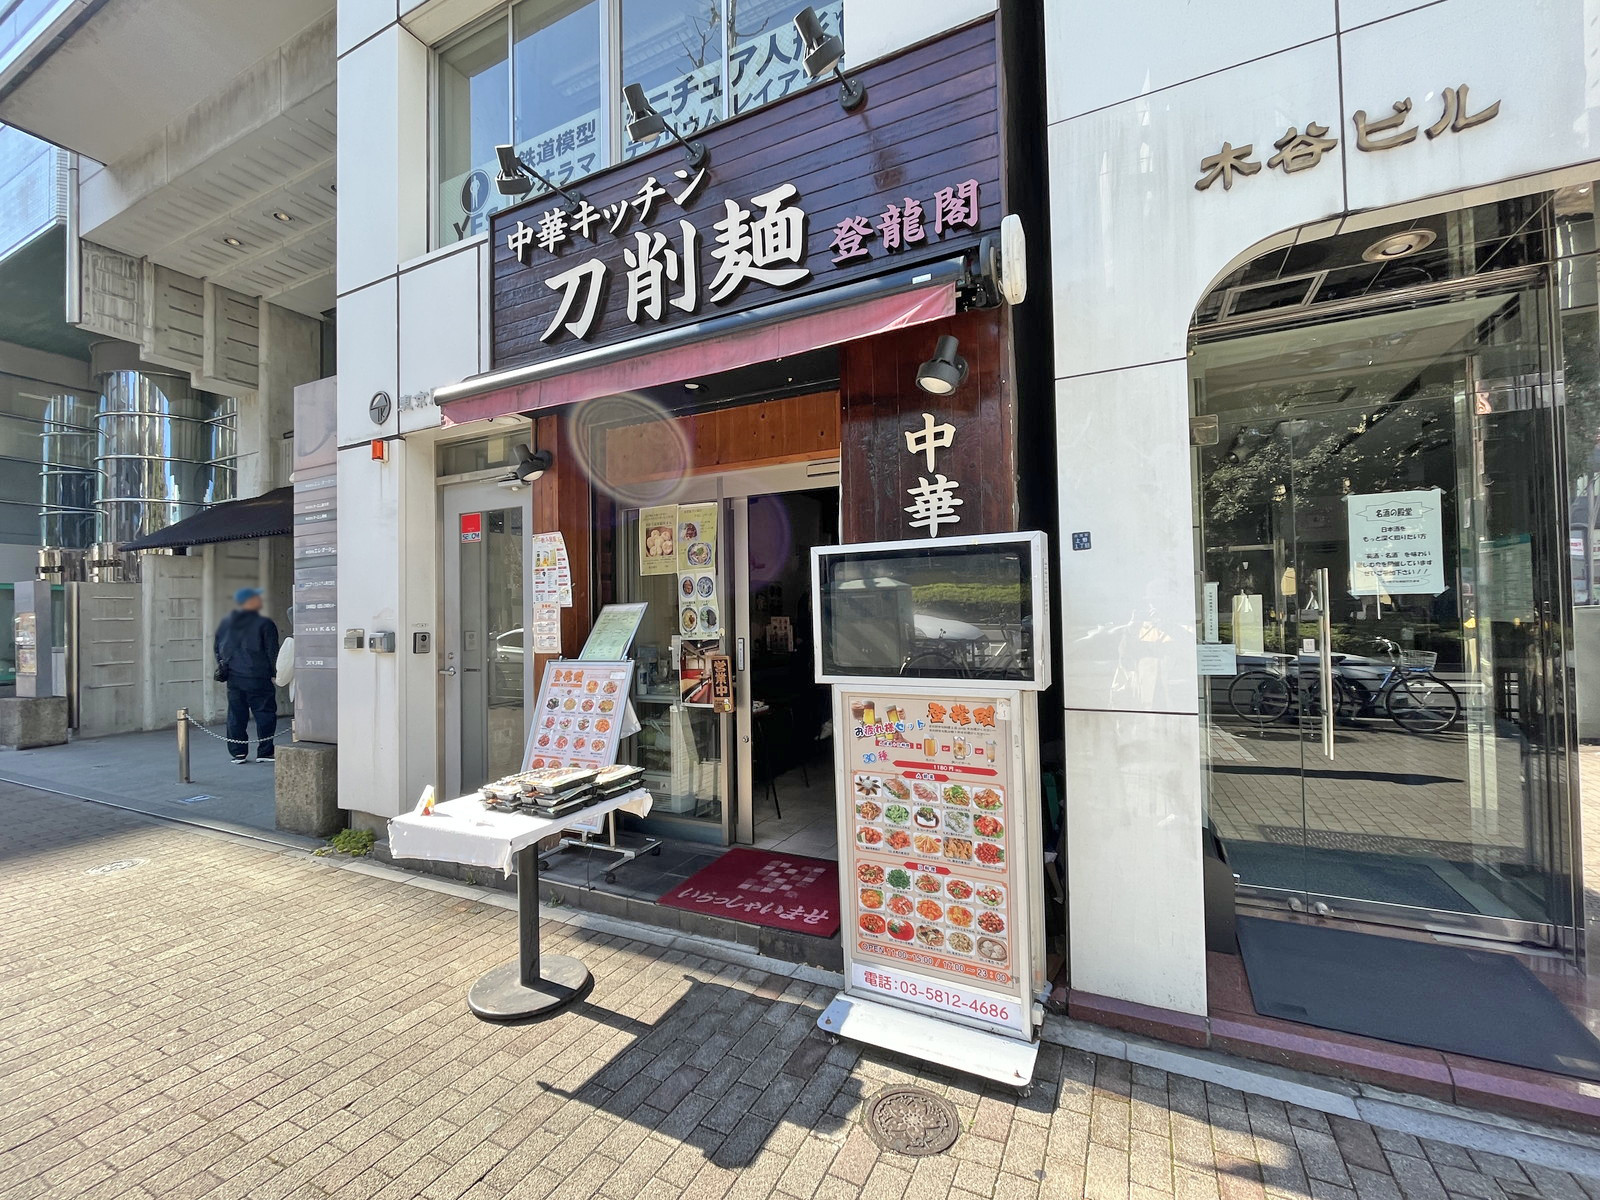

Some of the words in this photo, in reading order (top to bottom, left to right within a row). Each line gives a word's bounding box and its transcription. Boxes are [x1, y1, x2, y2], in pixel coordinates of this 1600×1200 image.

[1194, 83, 1501, 192] 木谷ビル
[507, 167, 706, 262] 中華キッチン
[829, 178, 980, 267] 登龍閣
[539, 183, 811, 342] 刀削麺
[904, 413, 964, 538] 中華
[713, 660, 728, 697] 営業中
[854, 719, 926, 738] お疲れ様セット
[677, 887, 829, 925] いらっしゃいませ
[861, 943, 885, 954] OPEN
